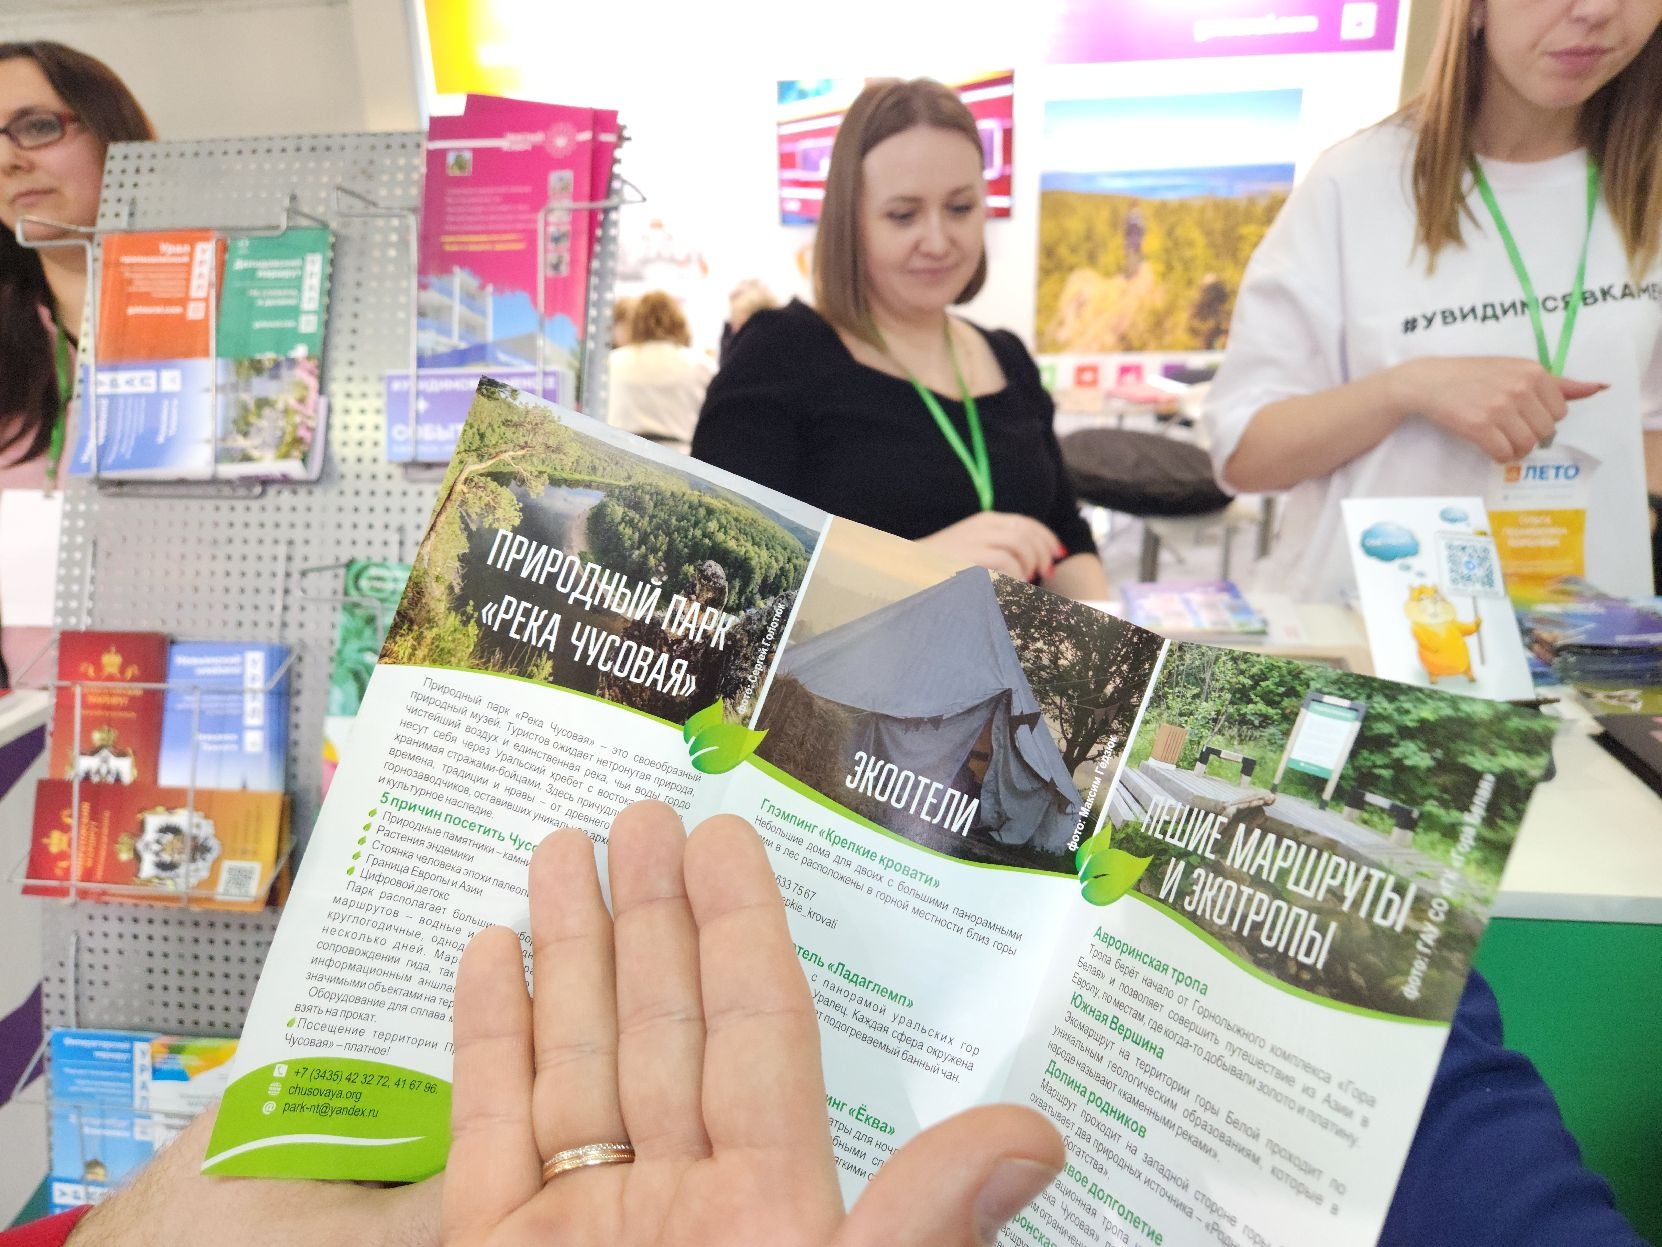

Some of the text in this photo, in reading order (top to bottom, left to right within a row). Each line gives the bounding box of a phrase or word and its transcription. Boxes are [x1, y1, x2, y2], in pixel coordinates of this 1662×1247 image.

[1523, 463, 1581, 482] ЛЕТО
[486, 528, 738, 652] ПРИРОДНЫЙ ПАРК
[480, 594, 698, 699] «РЕКА ЧУСОВАЯ»
[747, 644, 771, 688] Сергей
[760, 601, 788, 650] Голотюк
[403, 703, 692, 810] чистейший воздух и единственная река, чьи воды гордо
[408, 689, 697, 797] природный музей. Туристов ожидает нетронутая природа,
[421, 676, 703, 784] Природный парк «Река Чусовая» это своеобразный
[377, 775, 497, 819] и культурное наследие.
[379, 791, 540, 855] 5 причин посетить Чусо
[845, 750, 980, 837] ЭКООТЕЛИ
[1066, 734, 1119, 852] фото: Максим Гедзюк
[364, 852, 485, 897] Граница Европы и Азии
[374, 824, 476, 863] Растения эндемики
[758, 797, 941, 893] Глэмпинг «Крепкие кровати»
[1140, 794, 1419, 934] ПЕШИЕ МАРШРУТЫ
[358, 867, 451, 901] Цифровой детокс
[752, 814, 1023, 945] Небольшие дома для двоих с большими панорамными
[774, 842, 1017, 959] в лес расположены в горной местности близ горы
[790, 882, 805, 897] 75
[802, 887, 817, 902] 67
[1157, 856, 1338, 971] И ЭКОТРОПЫ
[314, 939, 456, 979] сопровождении гида, так
[320, 925, 429, 957] несколько дней.
[1091, 924, 1209, 1000] Авроринская тропа
[293, 1001, 379, 1026] взять на прокат.
[303, 969, 438, 1004] значимыми объектами на
[306, 985, 447, 1021] Оборудование для сплава
[809, 972, 981, 1059] с панорамой уральских гор
[824, 957, 917, 1011] «Ладаглемп»
[1086, 942, 1114, 968] Тропа
[1112, 957, 1141, 983] берёт
[1140, 974, 1175, 1000] начало
[1175, 993, 1189, 1007] от
[1190, 998, 1268, 1051] Горнолыжного
[282, 1032, 391, 1058] Чусовая» платное!
[295, 1016, 439, 1050] Посещение территории
[821, 1013, 962, 1084] подогреваемый банный чан.
[850, 1008, 891, 1036] Каждая
[889, 1028, 925, 1053] сфера
[924, 1043, 975, 1075] окружена
[1068, 990, 1168, 1062] Южная Вершина
[1069, 970, 1103, 1000] Европу,
[1101, 990, 1113, 1004] по
[1110, 996, 1148, 1026] местам,
[1146, 1017, 1164, 1035] где
[1161, 1026, 1204, 1059] когда-то
[1201, 1046, 1258, 1088] добывали
[287, 1084, 363, 1101] chusovaya.org
[292, 1065, 309, 1080] +7
[307, 1065, 345, 1086] (3435)
[343, 1070, 360, 1084] 42
[359, 1072, 375, 1086] 32
[375, 1074, 394, 1088] 72,
[393, 1076, 408, 1089] 41
[407, 1079, 423, 1091] 67
[1043, 1057, 1149, 1140] Долина родников
[1046, 1039, 1077, 1066] народе
[1073, 1059, 1118, 1093] называют
[1115, 1087, 1177, 1132] «каменными
[1050, 1023, 1105, 1065] уникальным
[1105, 1059, 1179, 1111] геологическим
[1061, 1009, 1117, 1054] Экомаршрут
[1117, 1046, 1131, 1062] на
[1132, 1055, 1192, 1100] территории
[1193, 1092, 1221, 1119] горы
[1223, 1109, 1262, 1143] Белой
[282, 1100, 380, 1119] park-nt@yandex.ru
[846, 1099, 900, 1137] «Ёква»
[1084, 1179, 1167, 1247] долголетие
